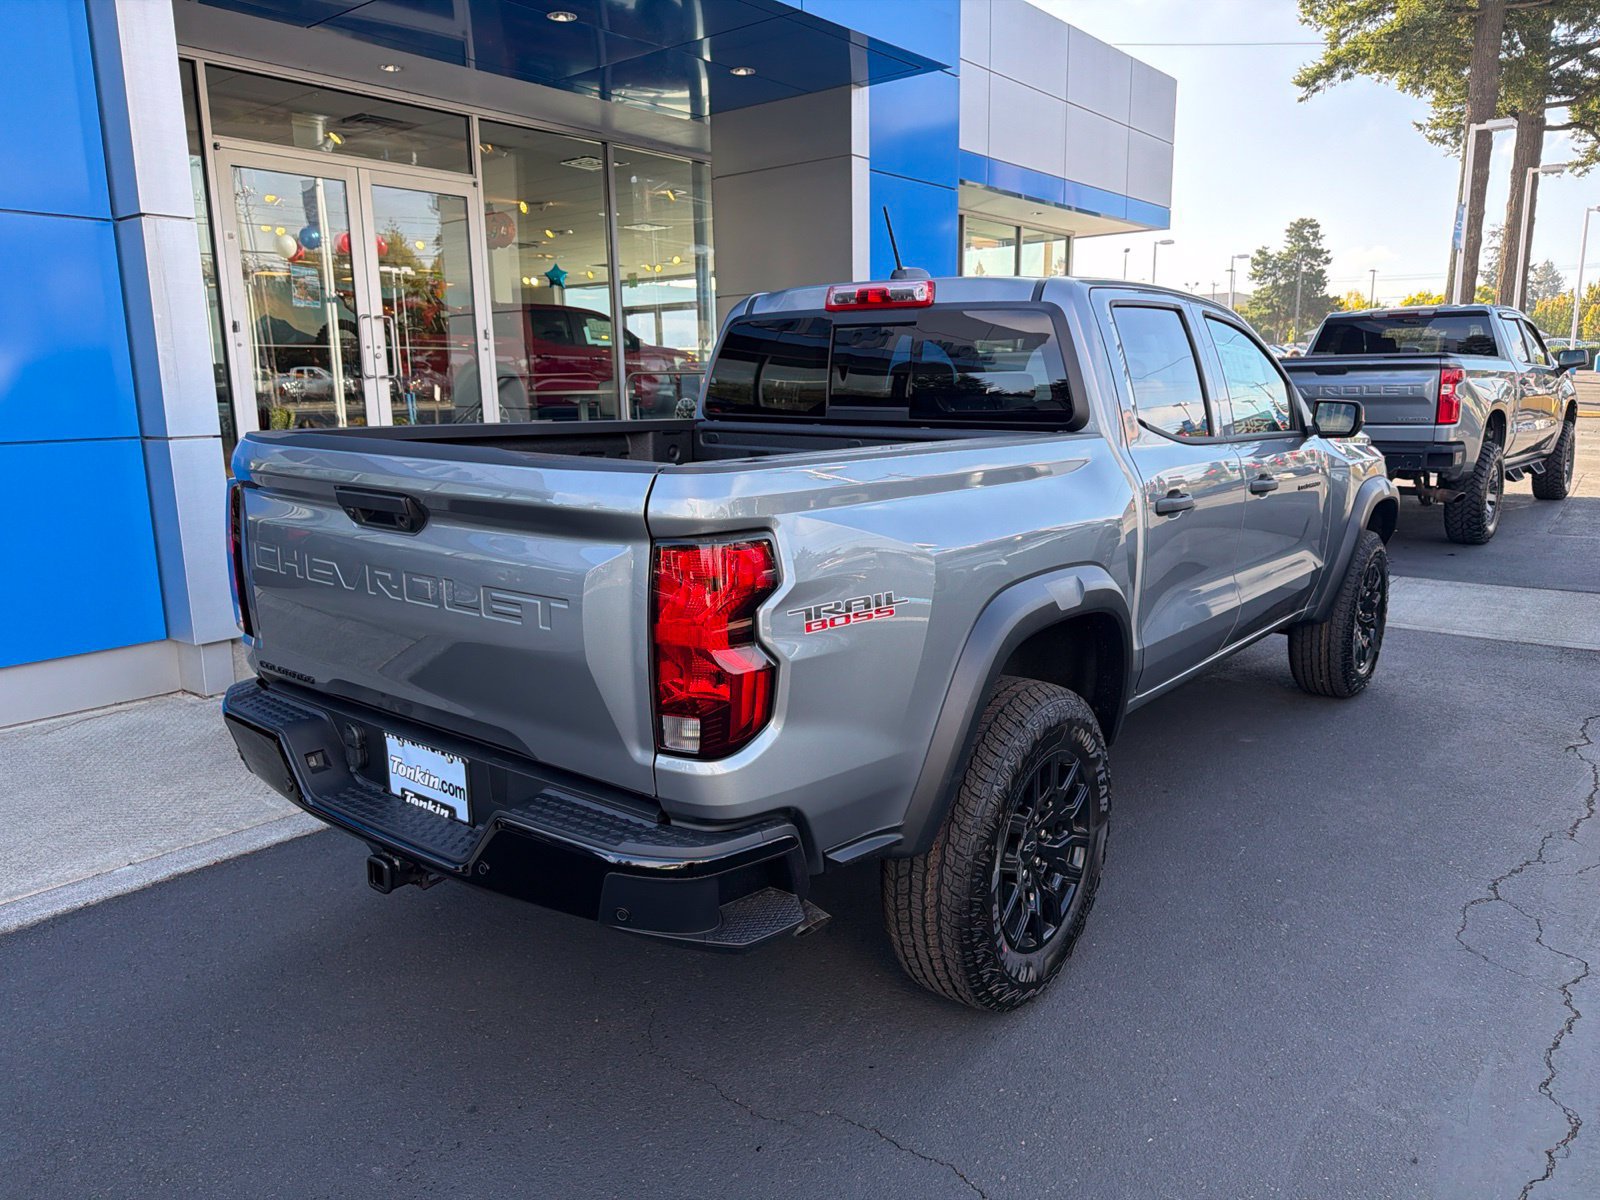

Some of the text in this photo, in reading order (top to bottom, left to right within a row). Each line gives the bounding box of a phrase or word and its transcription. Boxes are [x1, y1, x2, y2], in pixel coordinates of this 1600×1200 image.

[253, 541, 569, 631] CHEVROLET
[787, 591, 909, 622] TRAIL
[804, 605, 896, 635] BOSS
[390, 754, 466, 801] Tonkin.com
[404, 790, 450, 818] Tonkin
